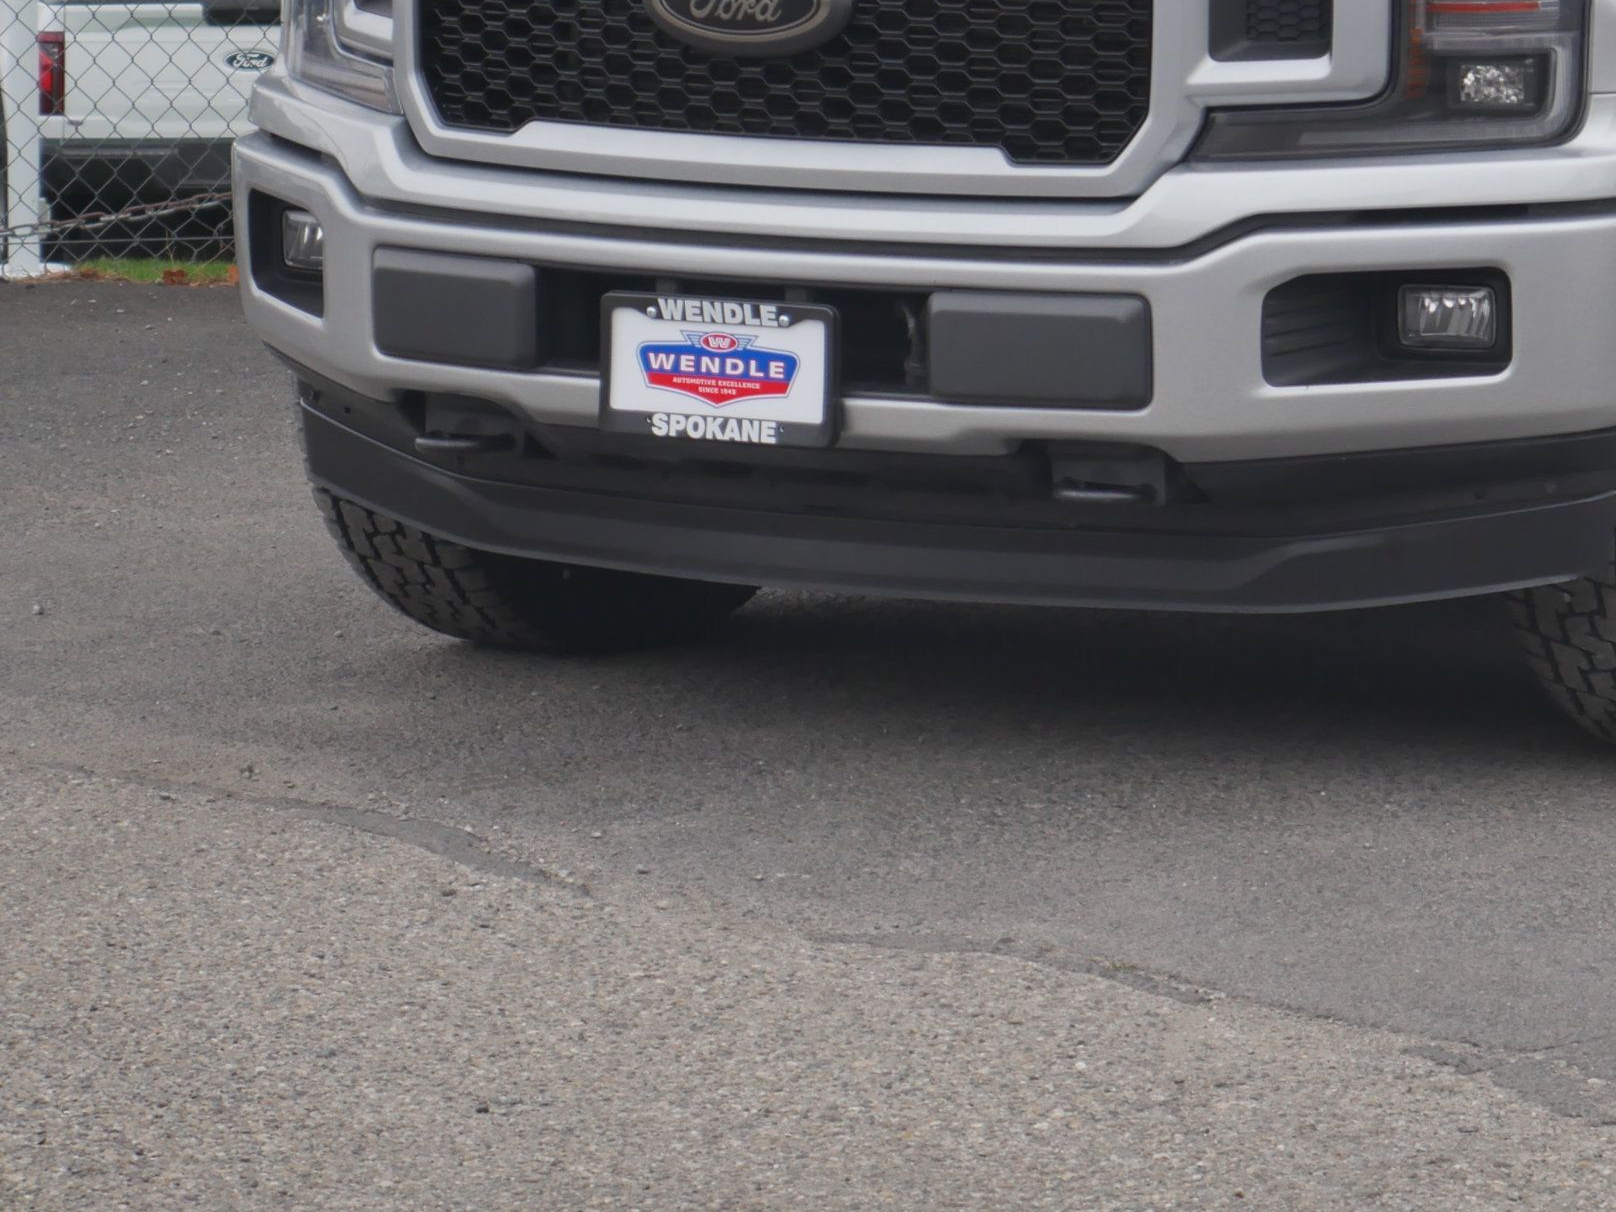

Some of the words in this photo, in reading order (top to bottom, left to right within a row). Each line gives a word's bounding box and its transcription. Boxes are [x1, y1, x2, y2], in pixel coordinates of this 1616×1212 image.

[232, 53, 268, 68] Ford
[657, 299, 778, 327] WENDLE
[648, 353, 784, 378] WENDLE
[672, 376, 717, 387] AUTOMOTIVE
[718, 380, 761, 390] EXCELLENCE
[698, 386, 719, 395] SINCE
[651, 413, 776, 444] SPOKANE
